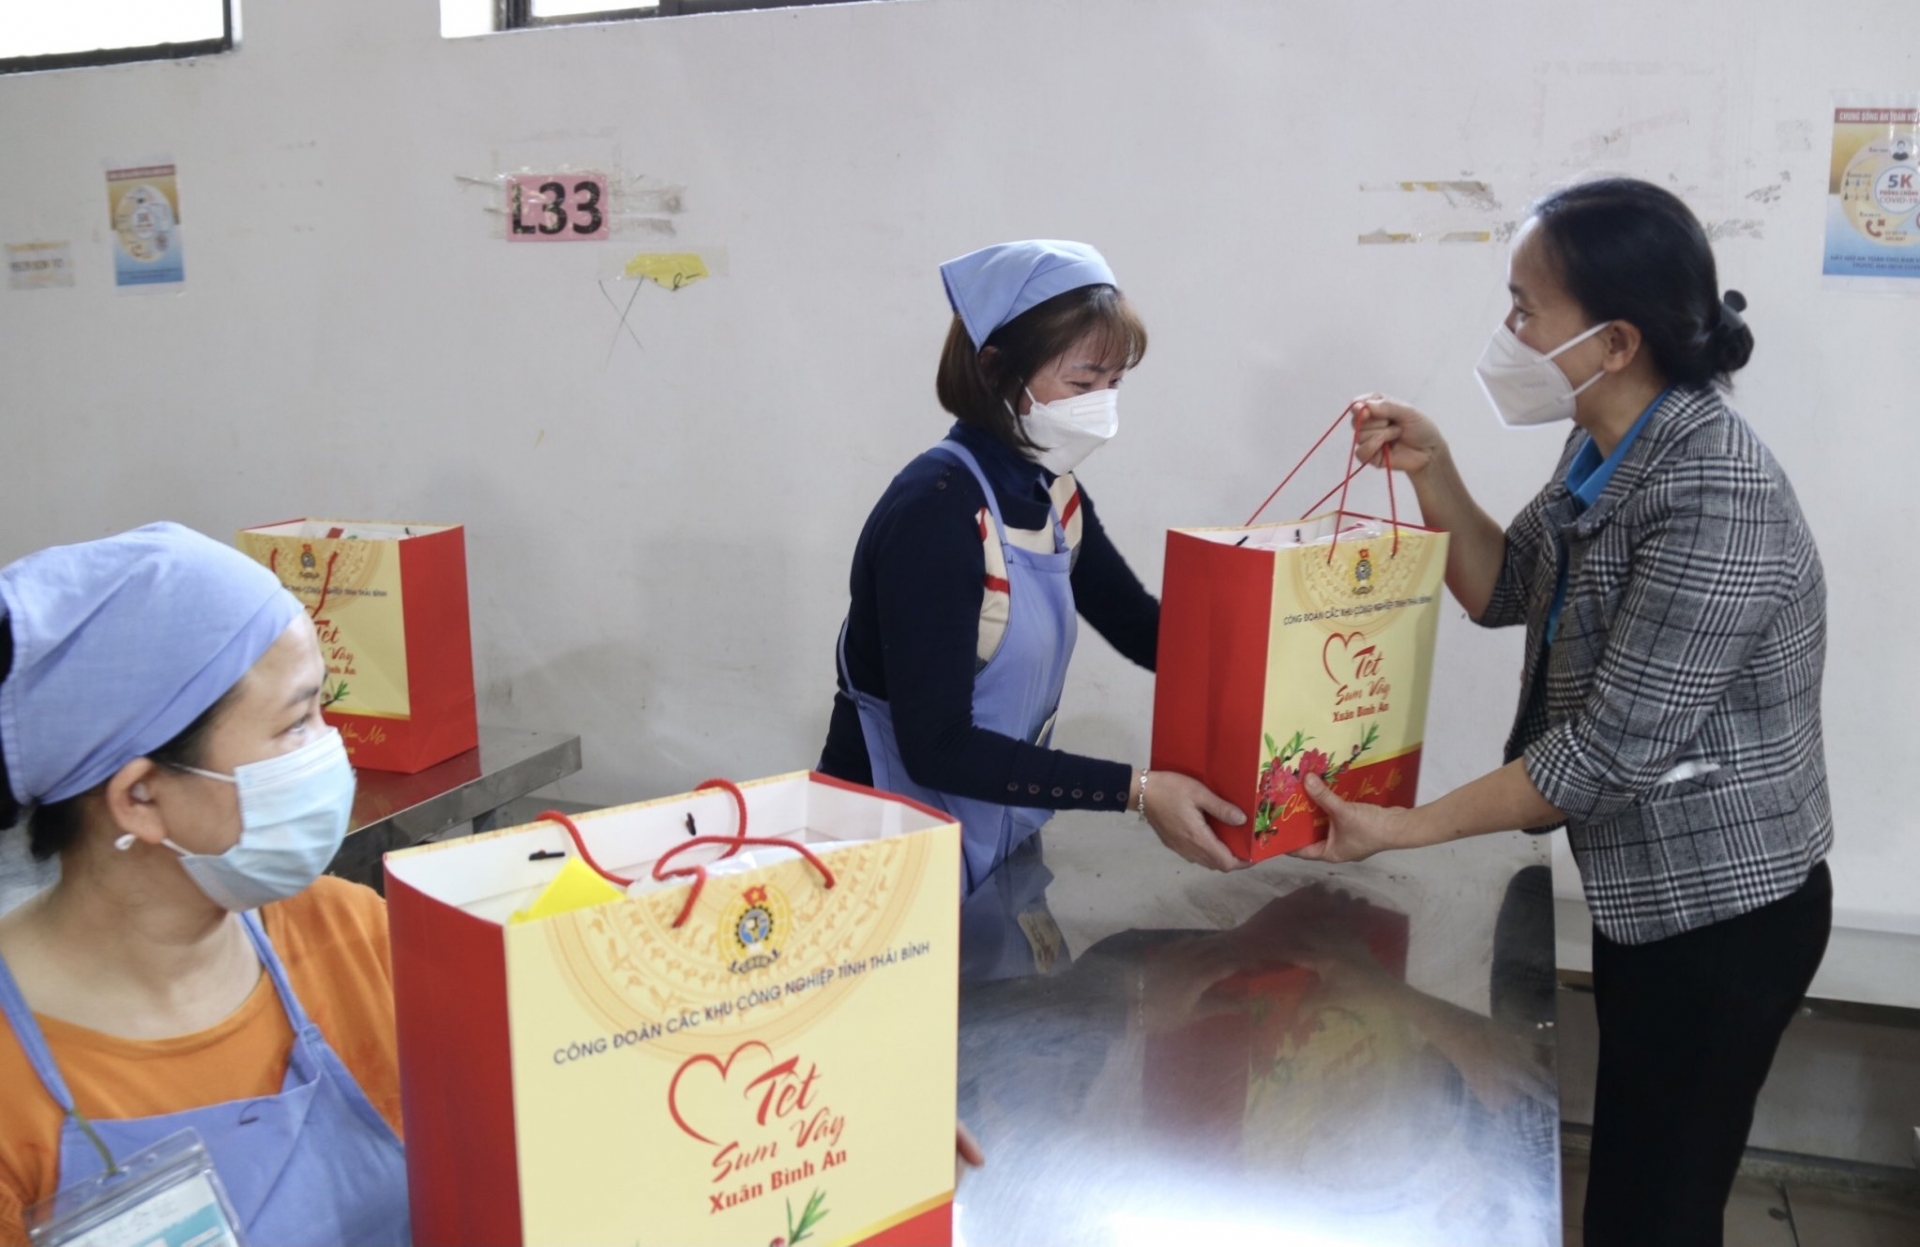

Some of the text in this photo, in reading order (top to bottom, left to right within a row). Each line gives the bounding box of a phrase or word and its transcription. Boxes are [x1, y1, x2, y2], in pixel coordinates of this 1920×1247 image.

[1888, 174, 1912, 189] 5K
[511, 181, 603, 235] L33
[1352, 644, 1385, 680] Tết
[1332, 710, 1354, 723] Xuân
[1377, 701, 1390, 713] An
[1335, 684, 1363, 706] Sum
[553, 941, 930, 1065] CÔNG ĐOÀN CÁC KHU CÔNG NGHIỆP TỈNH THÁI BÌNH
[743, 1054, 822, 1126] Tết
[708, 1149, 847, 1215] Xuân Bình An
[711, 1140, 778, 1183] Sum
